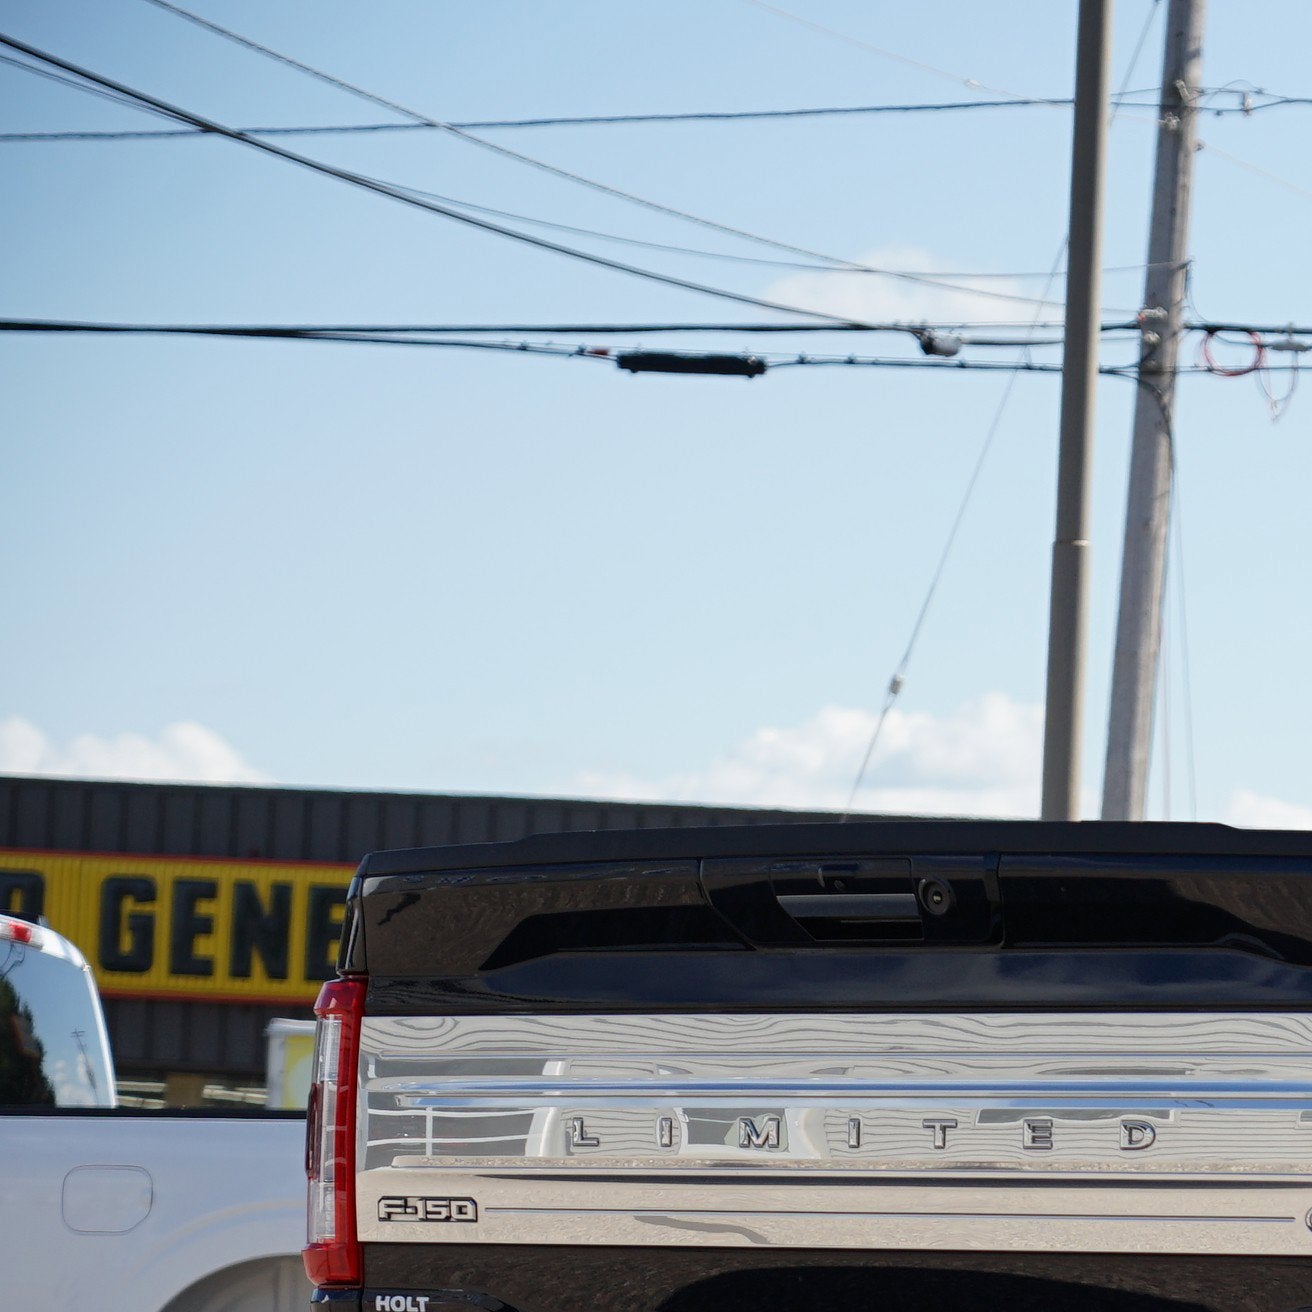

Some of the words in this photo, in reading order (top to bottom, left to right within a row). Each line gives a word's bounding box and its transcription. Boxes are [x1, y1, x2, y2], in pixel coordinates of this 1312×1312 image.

[570, 1116, 1158, 1151] LIMITED
[377, 1195, 479, 1223] F-150
[375, 1295, 430, 1312] HOLT
